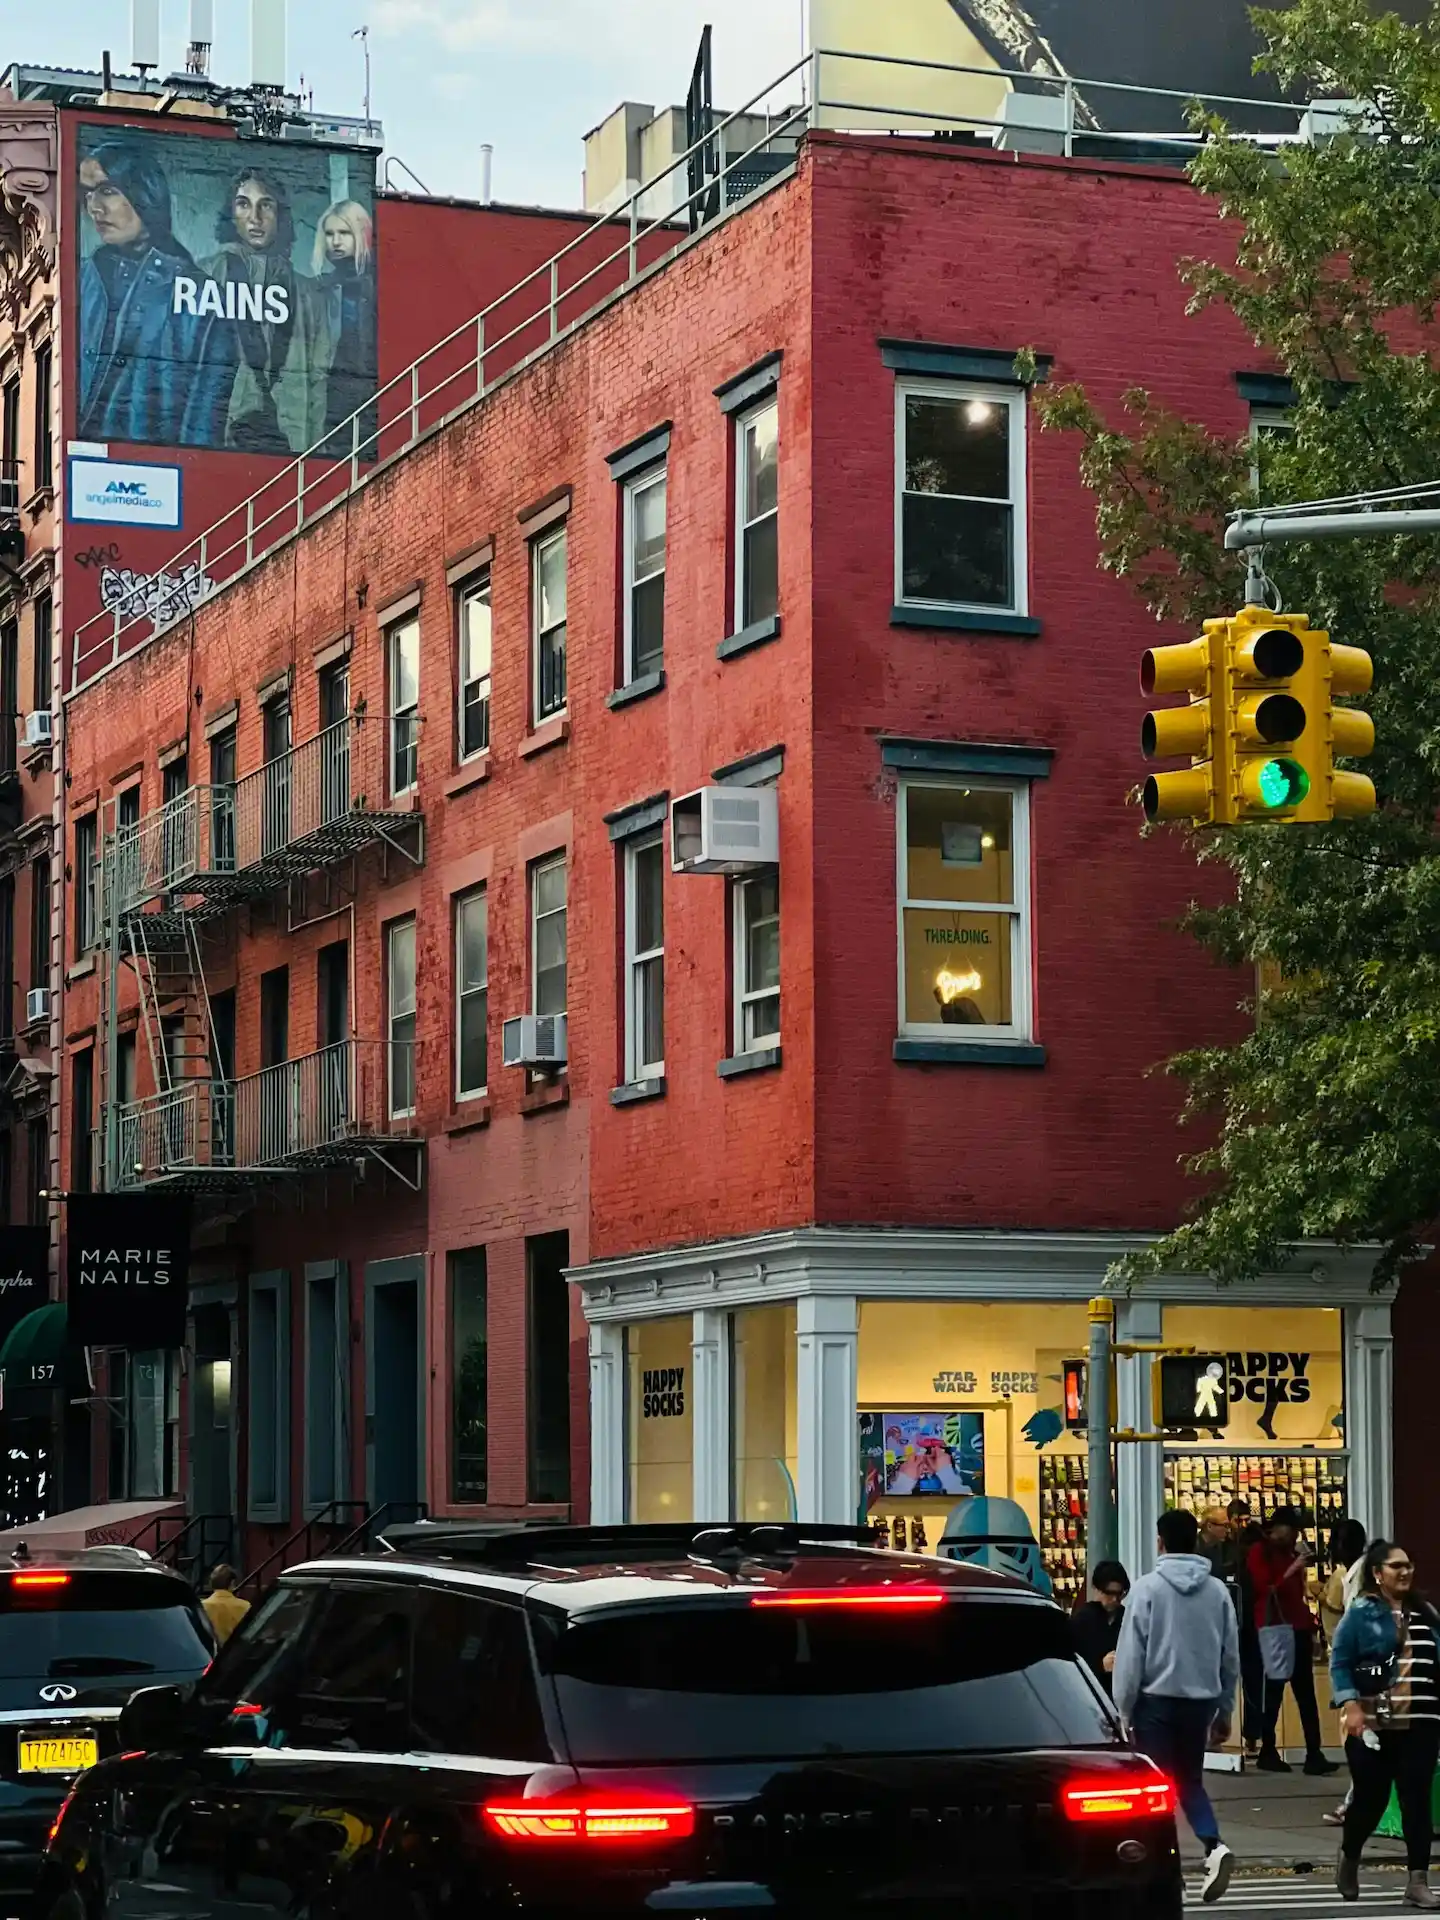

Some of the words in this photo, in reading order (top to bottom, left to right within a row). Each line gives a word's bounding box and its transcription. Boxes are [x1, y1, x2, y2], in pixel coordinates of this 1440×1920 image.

[173, 276, 289, 324] RAINS
[105, 480, 147, 496] AMC
[81, 1249, 172, 1264] MARIE
[80, 1269, 171, 1285] NAILS
[31, 1365, 55, 1380] 157
[1226, 1352, 1310, 1377] APPY
[643, 1367, 684, 1394] HAPPY
[932, 1371, 978, 1383] STAR
[991, 1371, 1039, 1382] HAPPY
[932, 1382, 978, 1393] WARS
[991, 1382, 1039, 1393] SOCKS
[1229, 1378, 1311, 1403] OCKS
[643, 1392, 684, 1418] SOCKS
[26, 1741, 91, 1763] T772475C
[713, 1810, 874, 1832] RANGE
